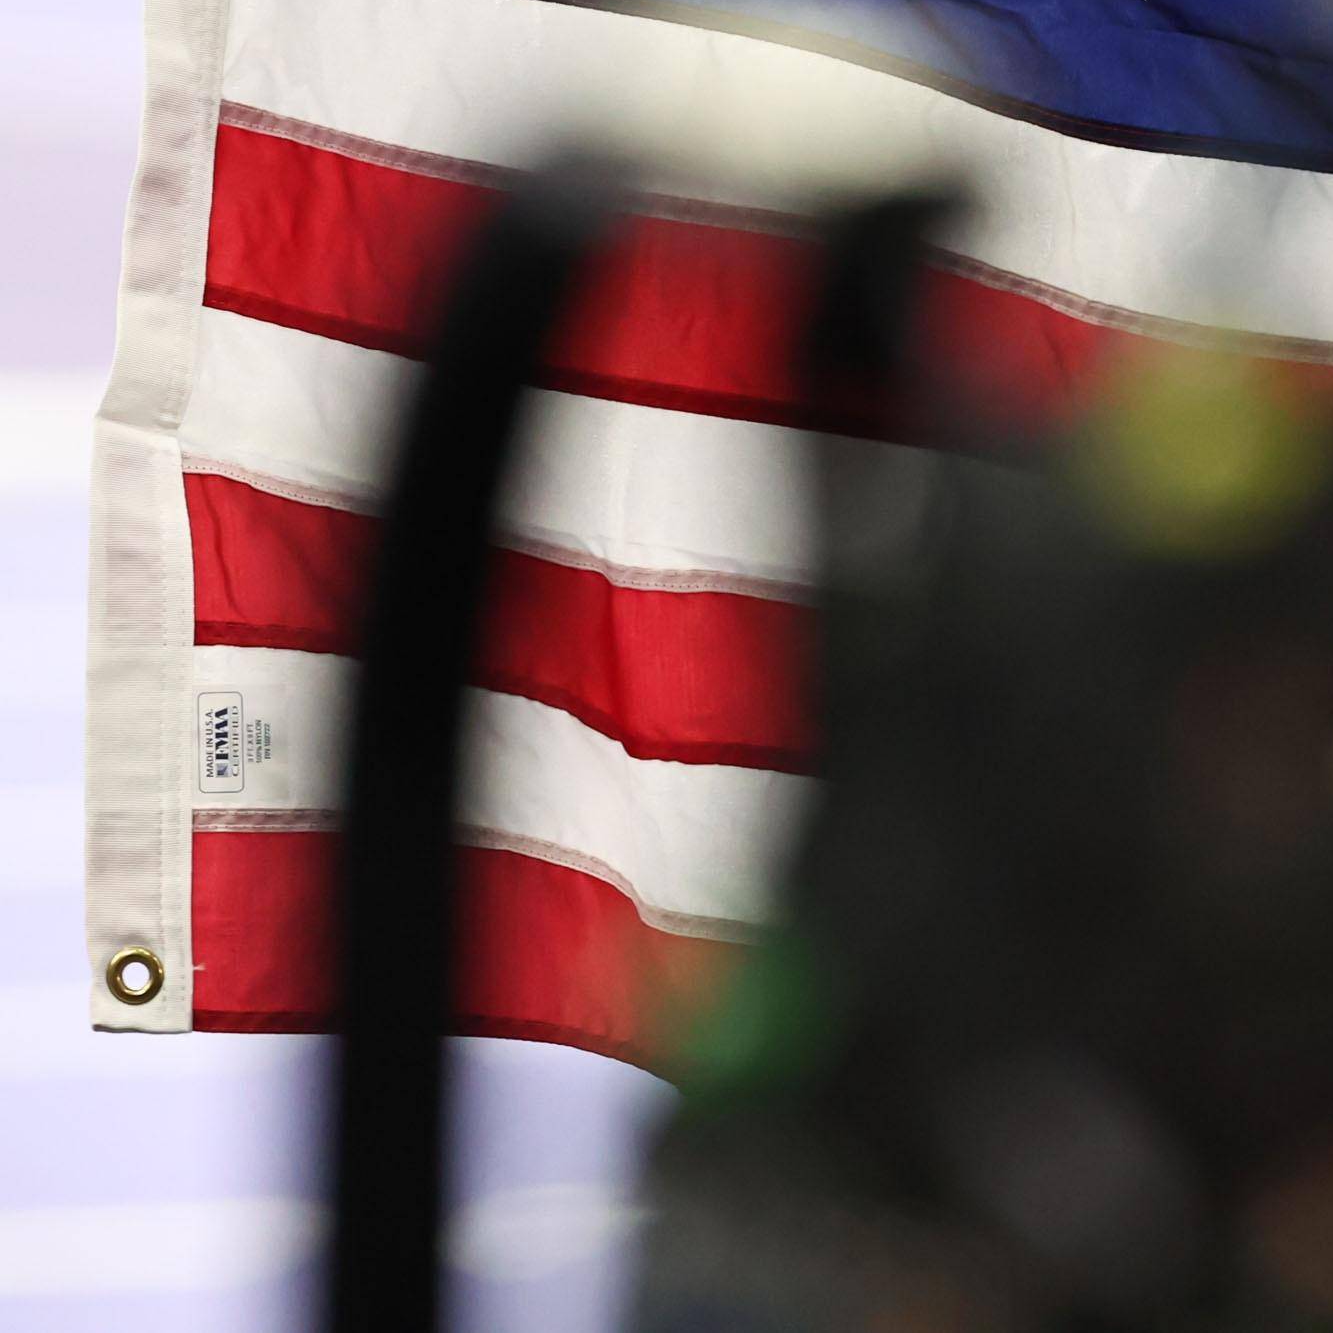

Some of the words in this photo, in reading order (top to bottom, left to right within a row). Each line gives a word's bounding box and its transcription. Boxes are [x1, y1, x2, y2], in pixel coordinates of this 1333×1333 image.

[205, 708, 214, 735] U.S.A.
[215, 707, 229, 760] FMAA
[205, 737, 214, 747] IN
[205, 750, 214, 777] MADE
